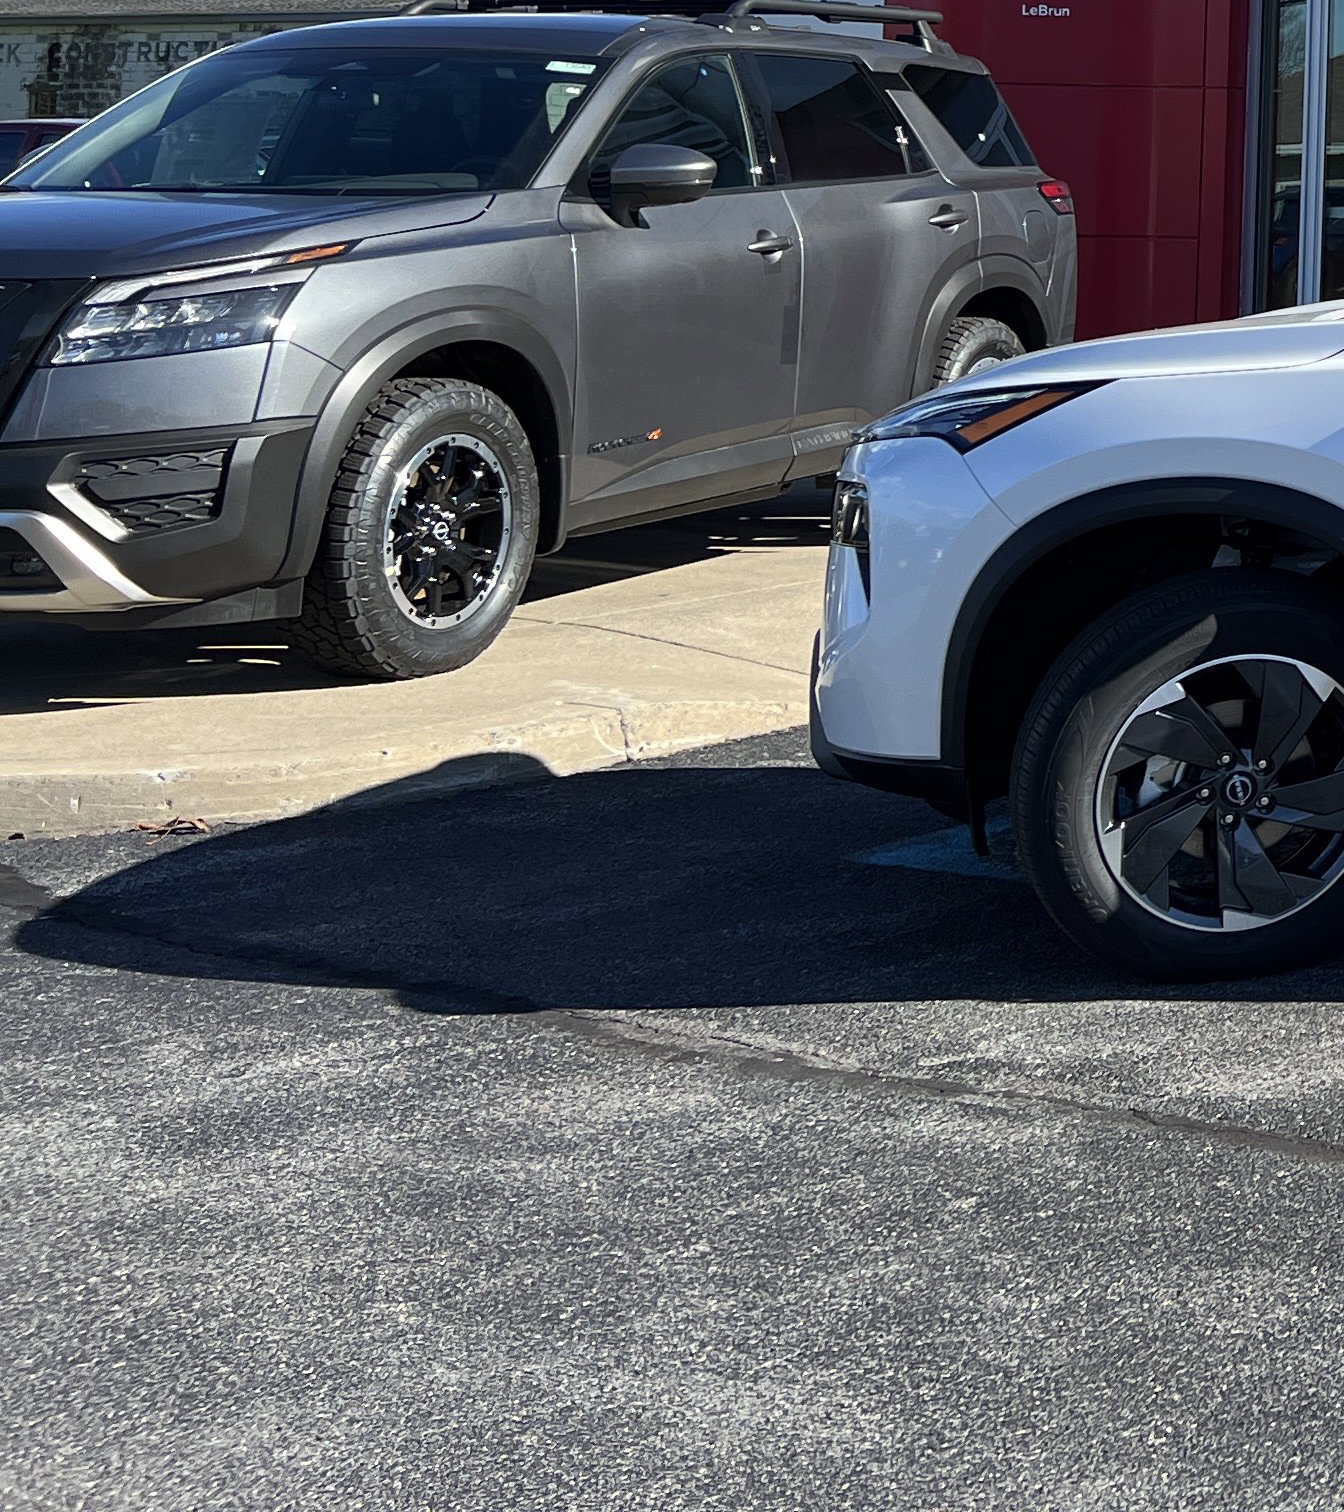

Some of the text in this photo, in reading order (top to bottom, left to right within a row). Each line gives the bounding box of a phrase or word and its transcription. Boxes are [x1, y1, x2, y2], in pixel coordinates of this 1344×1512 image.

[1021, 4, 1070, 16] LeBrun
[0, 40, 235, 65] K CONTRUCT
